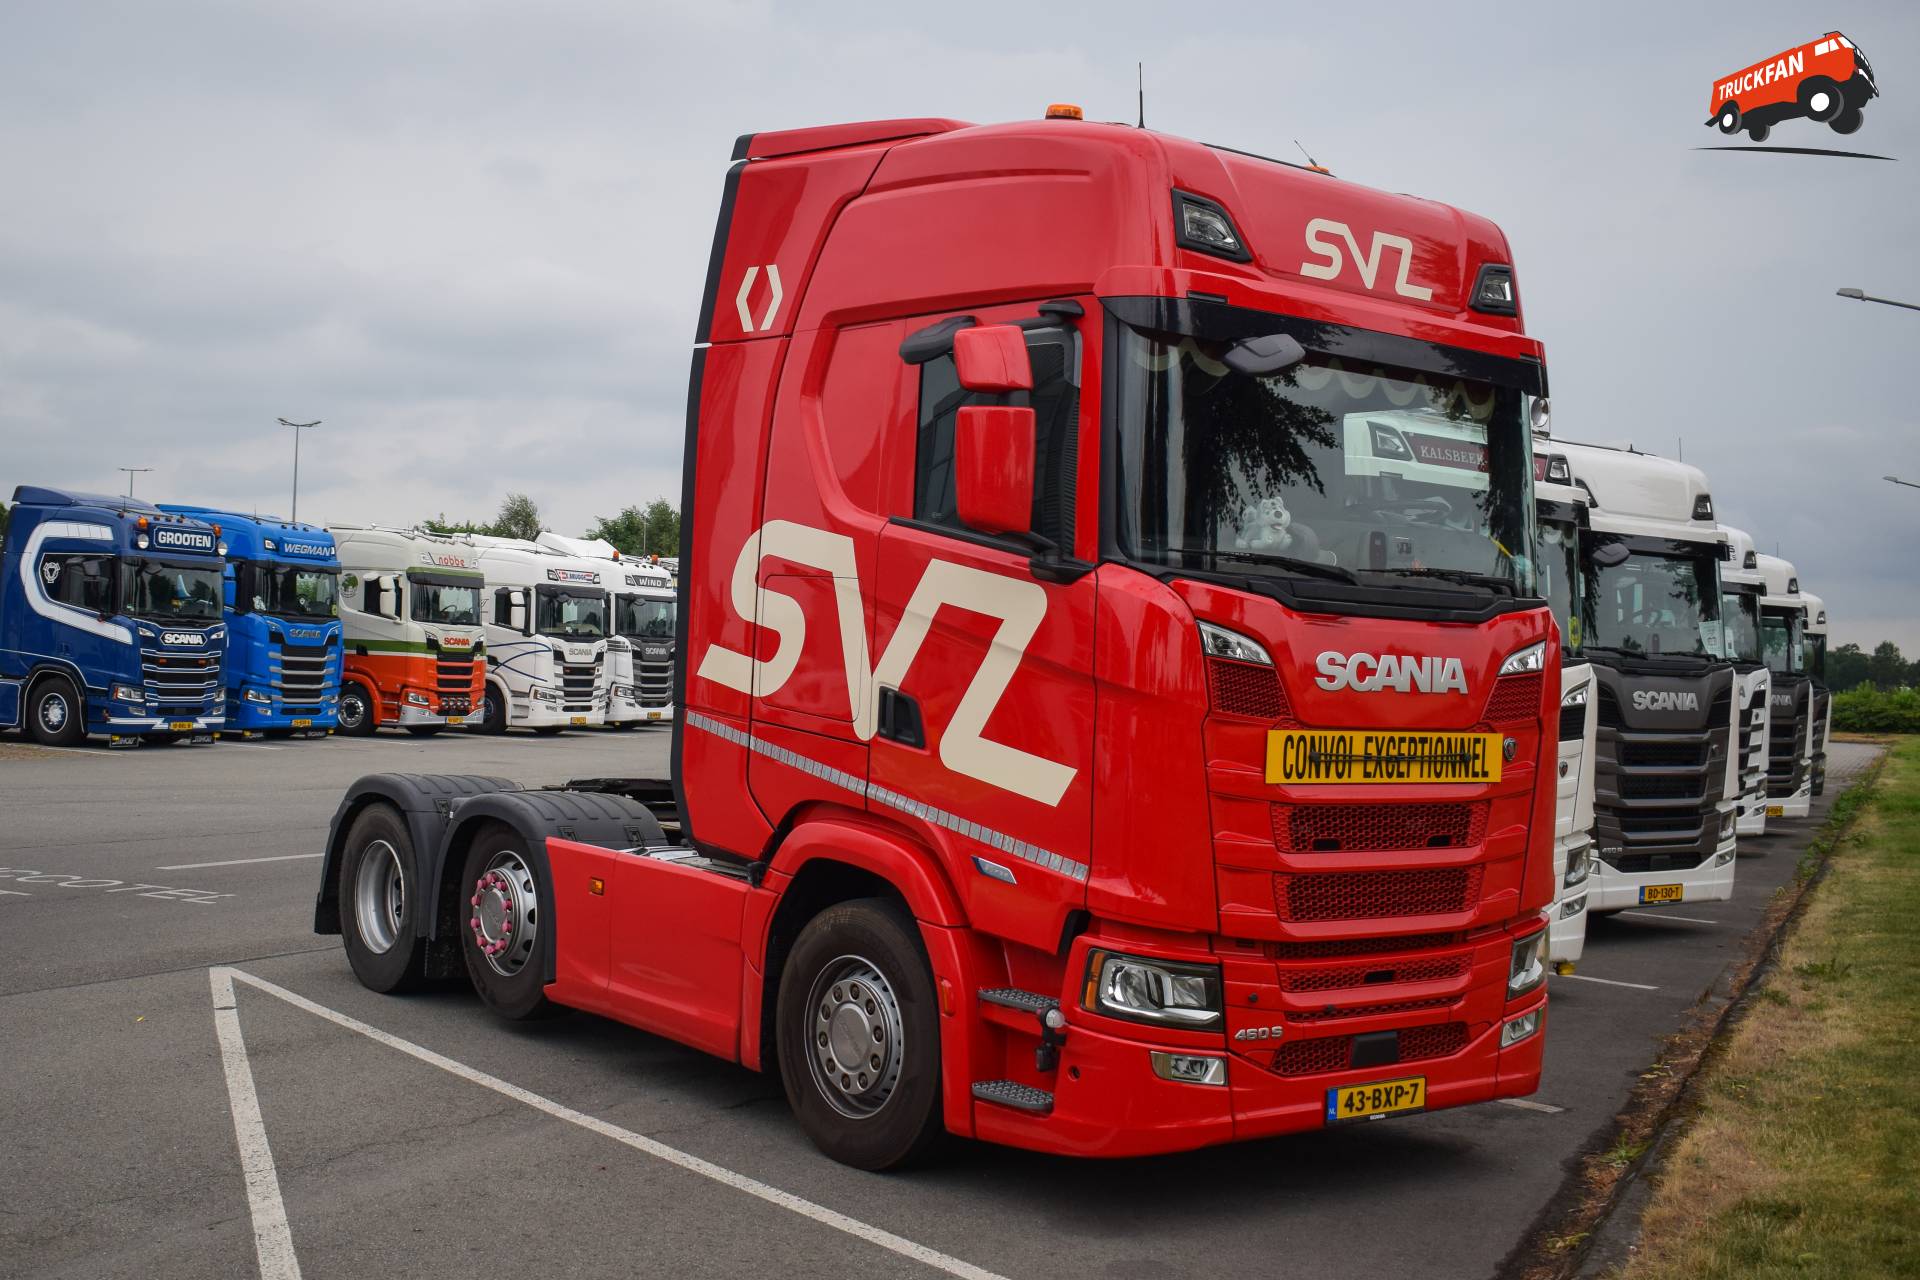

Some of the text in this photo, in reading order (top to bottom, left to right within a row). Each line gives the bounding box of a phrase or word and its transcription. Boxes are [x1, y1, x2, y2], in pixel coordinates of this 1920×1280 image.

[1300, 218, 1432, 301] SVZ
[158, 531, 211, 547] GROOTEN
[284, 543, 330, 556] WEGMAN
[438, 554, 465, 567] nobbe
[640, 577, 662, 587] WIND
[164, 633, 204, 645] SCANIA
[444, 636, 470, 646] SCANIA
[568, 647, 593, 656] SCANIA
[645, 647, 668, 655] SCANIA
[696, 519, 1078, 808] SVZ
[1314, 651, 1469, 694] SCANIA
[1632, 690, 1699, 711] SCANIA
[1282, 734, 1489, 779] CONVOI EXCEPTIONNEL
[0, 867, 237, 904] CCOTEL
[1648, 886, 1680, 899] BD-130-T
[1234, 1025, 1284, 1041] 460 S
[1343, 1082, 1420, 1113] 43-BXP-7
